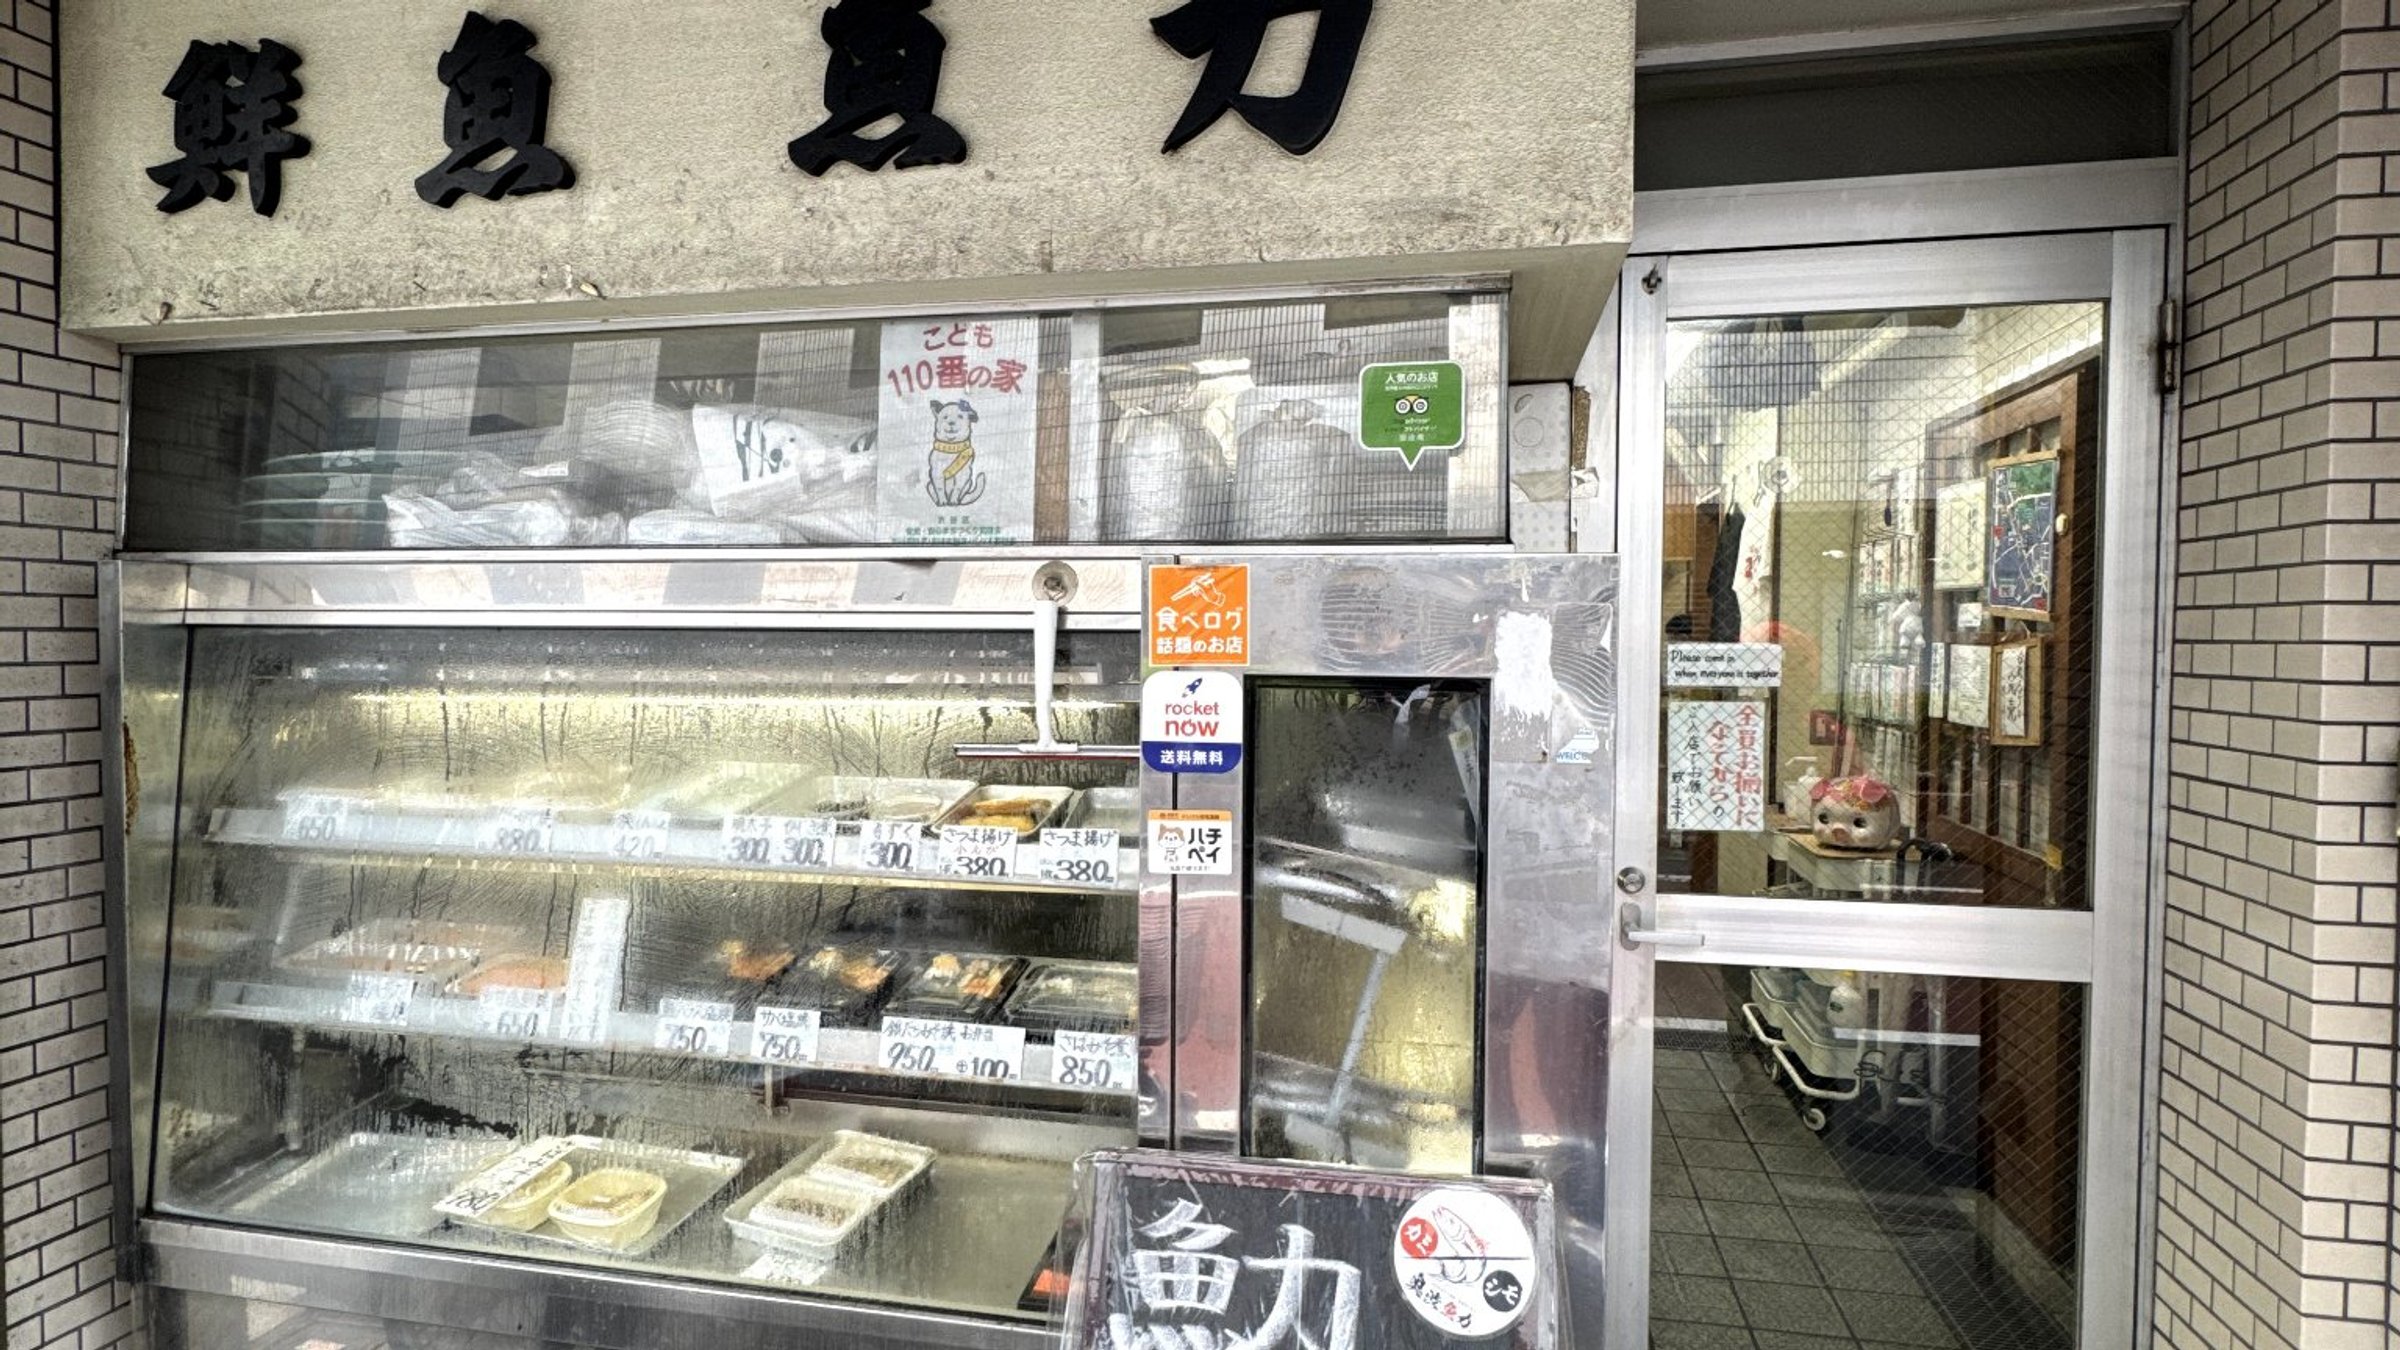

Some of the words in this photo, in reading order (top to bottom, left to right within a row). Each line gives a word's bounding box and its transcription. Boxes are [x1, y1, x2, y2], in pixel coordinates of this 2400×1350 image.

[887, 355, 1028, 397] 110番の家
[1385, 370, 1439, 385] 人気のお店
[1155, 605, 1243, 632] 食べログ
[1156, 635, 1243, 655] 話題のお店
[1670, 650, 1701, 663] Please
[1746, 667, 1779, 680] together
[1165, 700, 1220, 715] rocket
[1165, 718, 1219, 737] now
[1160, 749, 1224, 766] 送料無料
[944, 827, 1016, 847] さつま揚げ
[1044, 829, 1119, 848] さつま揚げ
[1188, 827, 1222, 845] ハチ
[1188, 846, 1221, 863] ペイ
